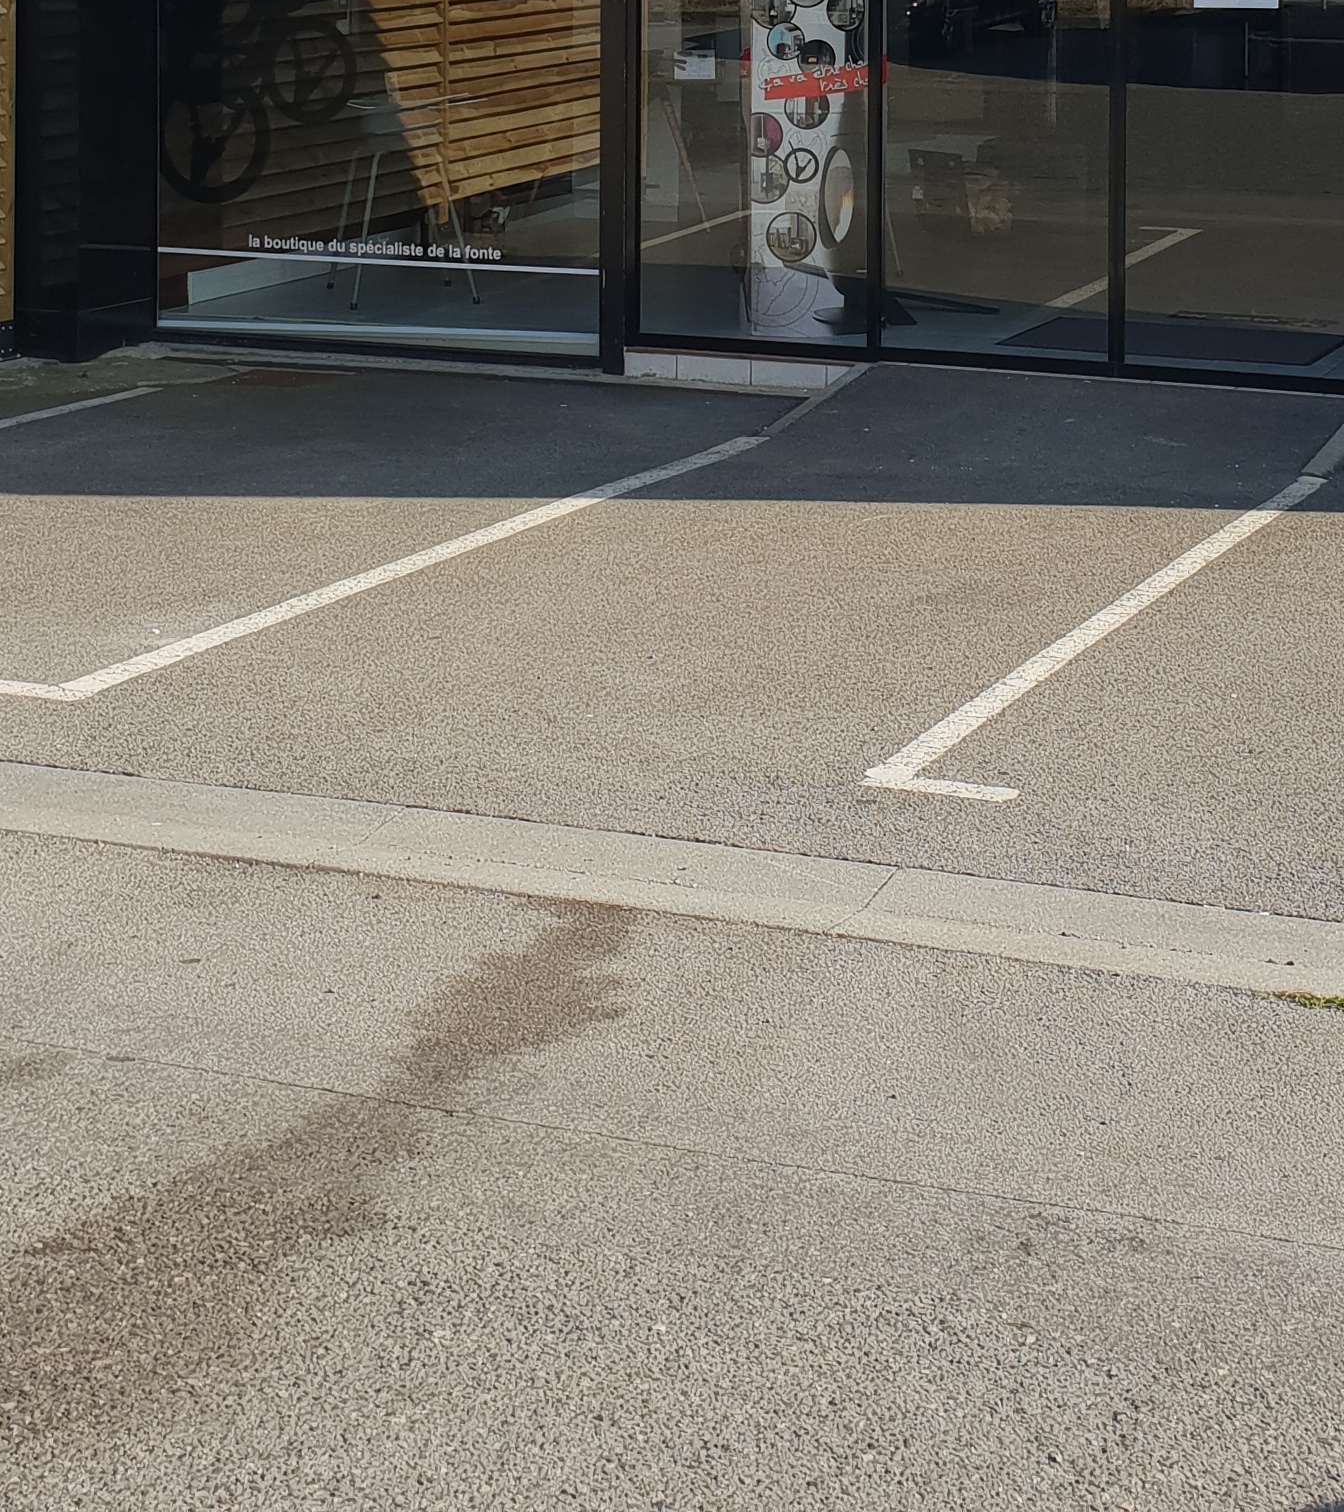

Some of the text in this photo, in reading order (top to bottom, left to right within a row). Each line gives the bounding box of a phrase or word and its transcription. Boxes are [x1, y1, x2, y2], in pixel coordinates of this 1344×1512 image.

[248, 234, 502, 260] la boutique du spécialiste de la fonte
